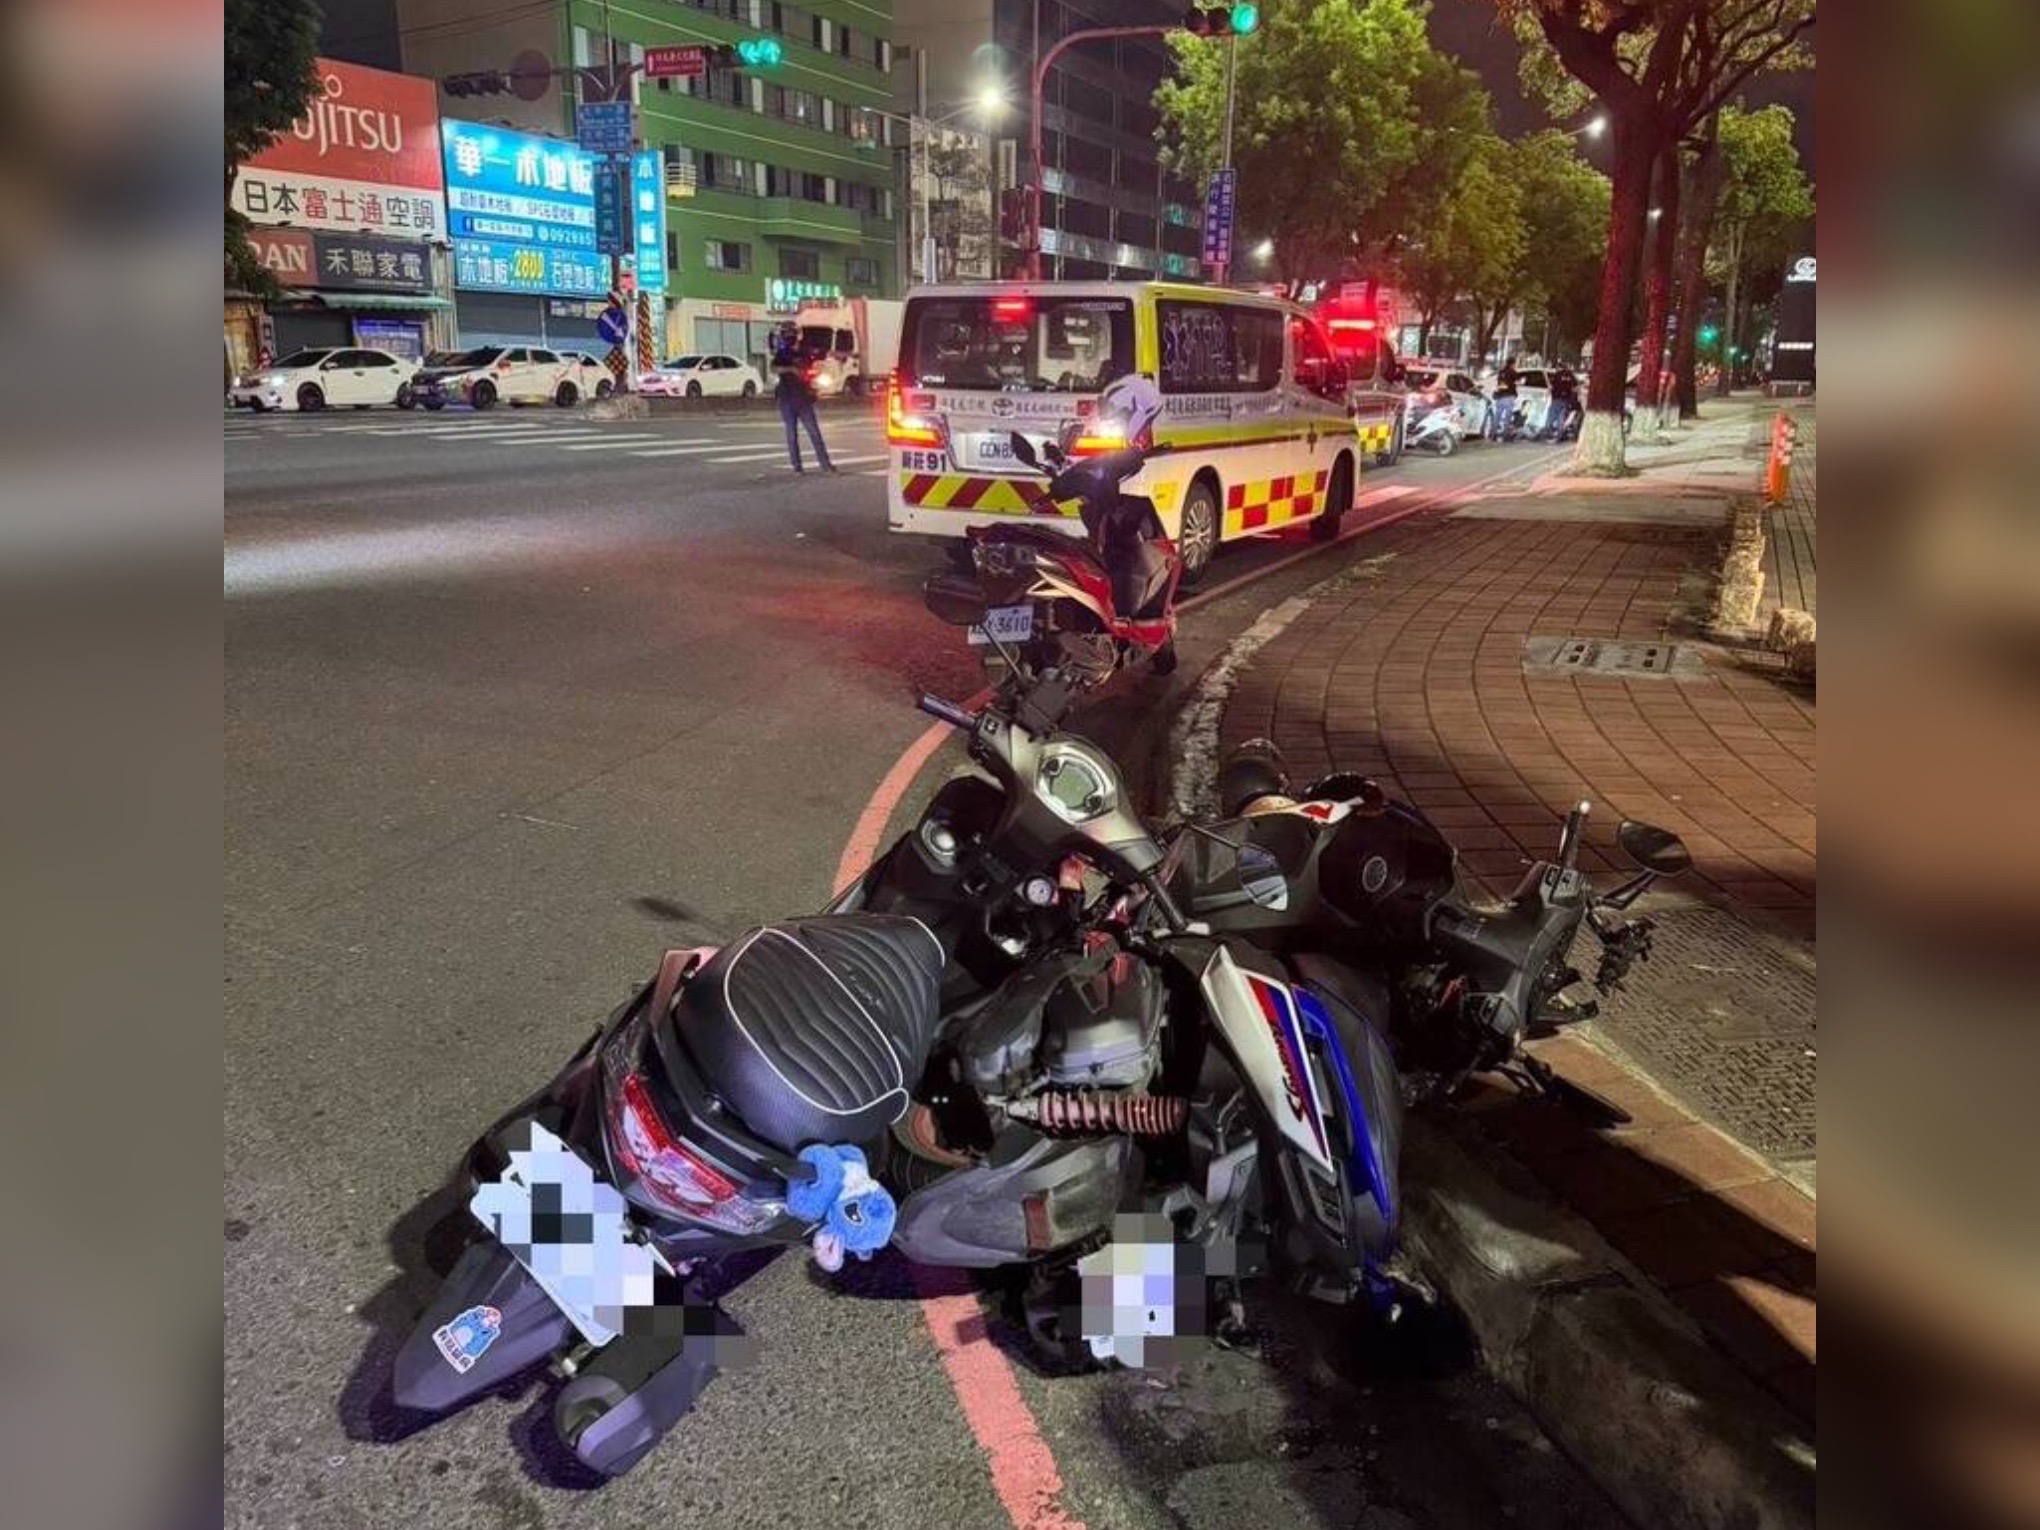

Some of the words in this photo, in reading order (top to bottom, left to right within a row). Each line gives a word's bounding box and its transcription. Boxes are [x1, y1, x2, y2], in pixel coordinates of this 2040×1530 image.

[293, 97, 402, 156] UJITSU
[243, 179, 435, 231] 日本富士通空調
[247, 241, 309, 272] RAN
[325, 248, 424, 281] 禾聯家電
